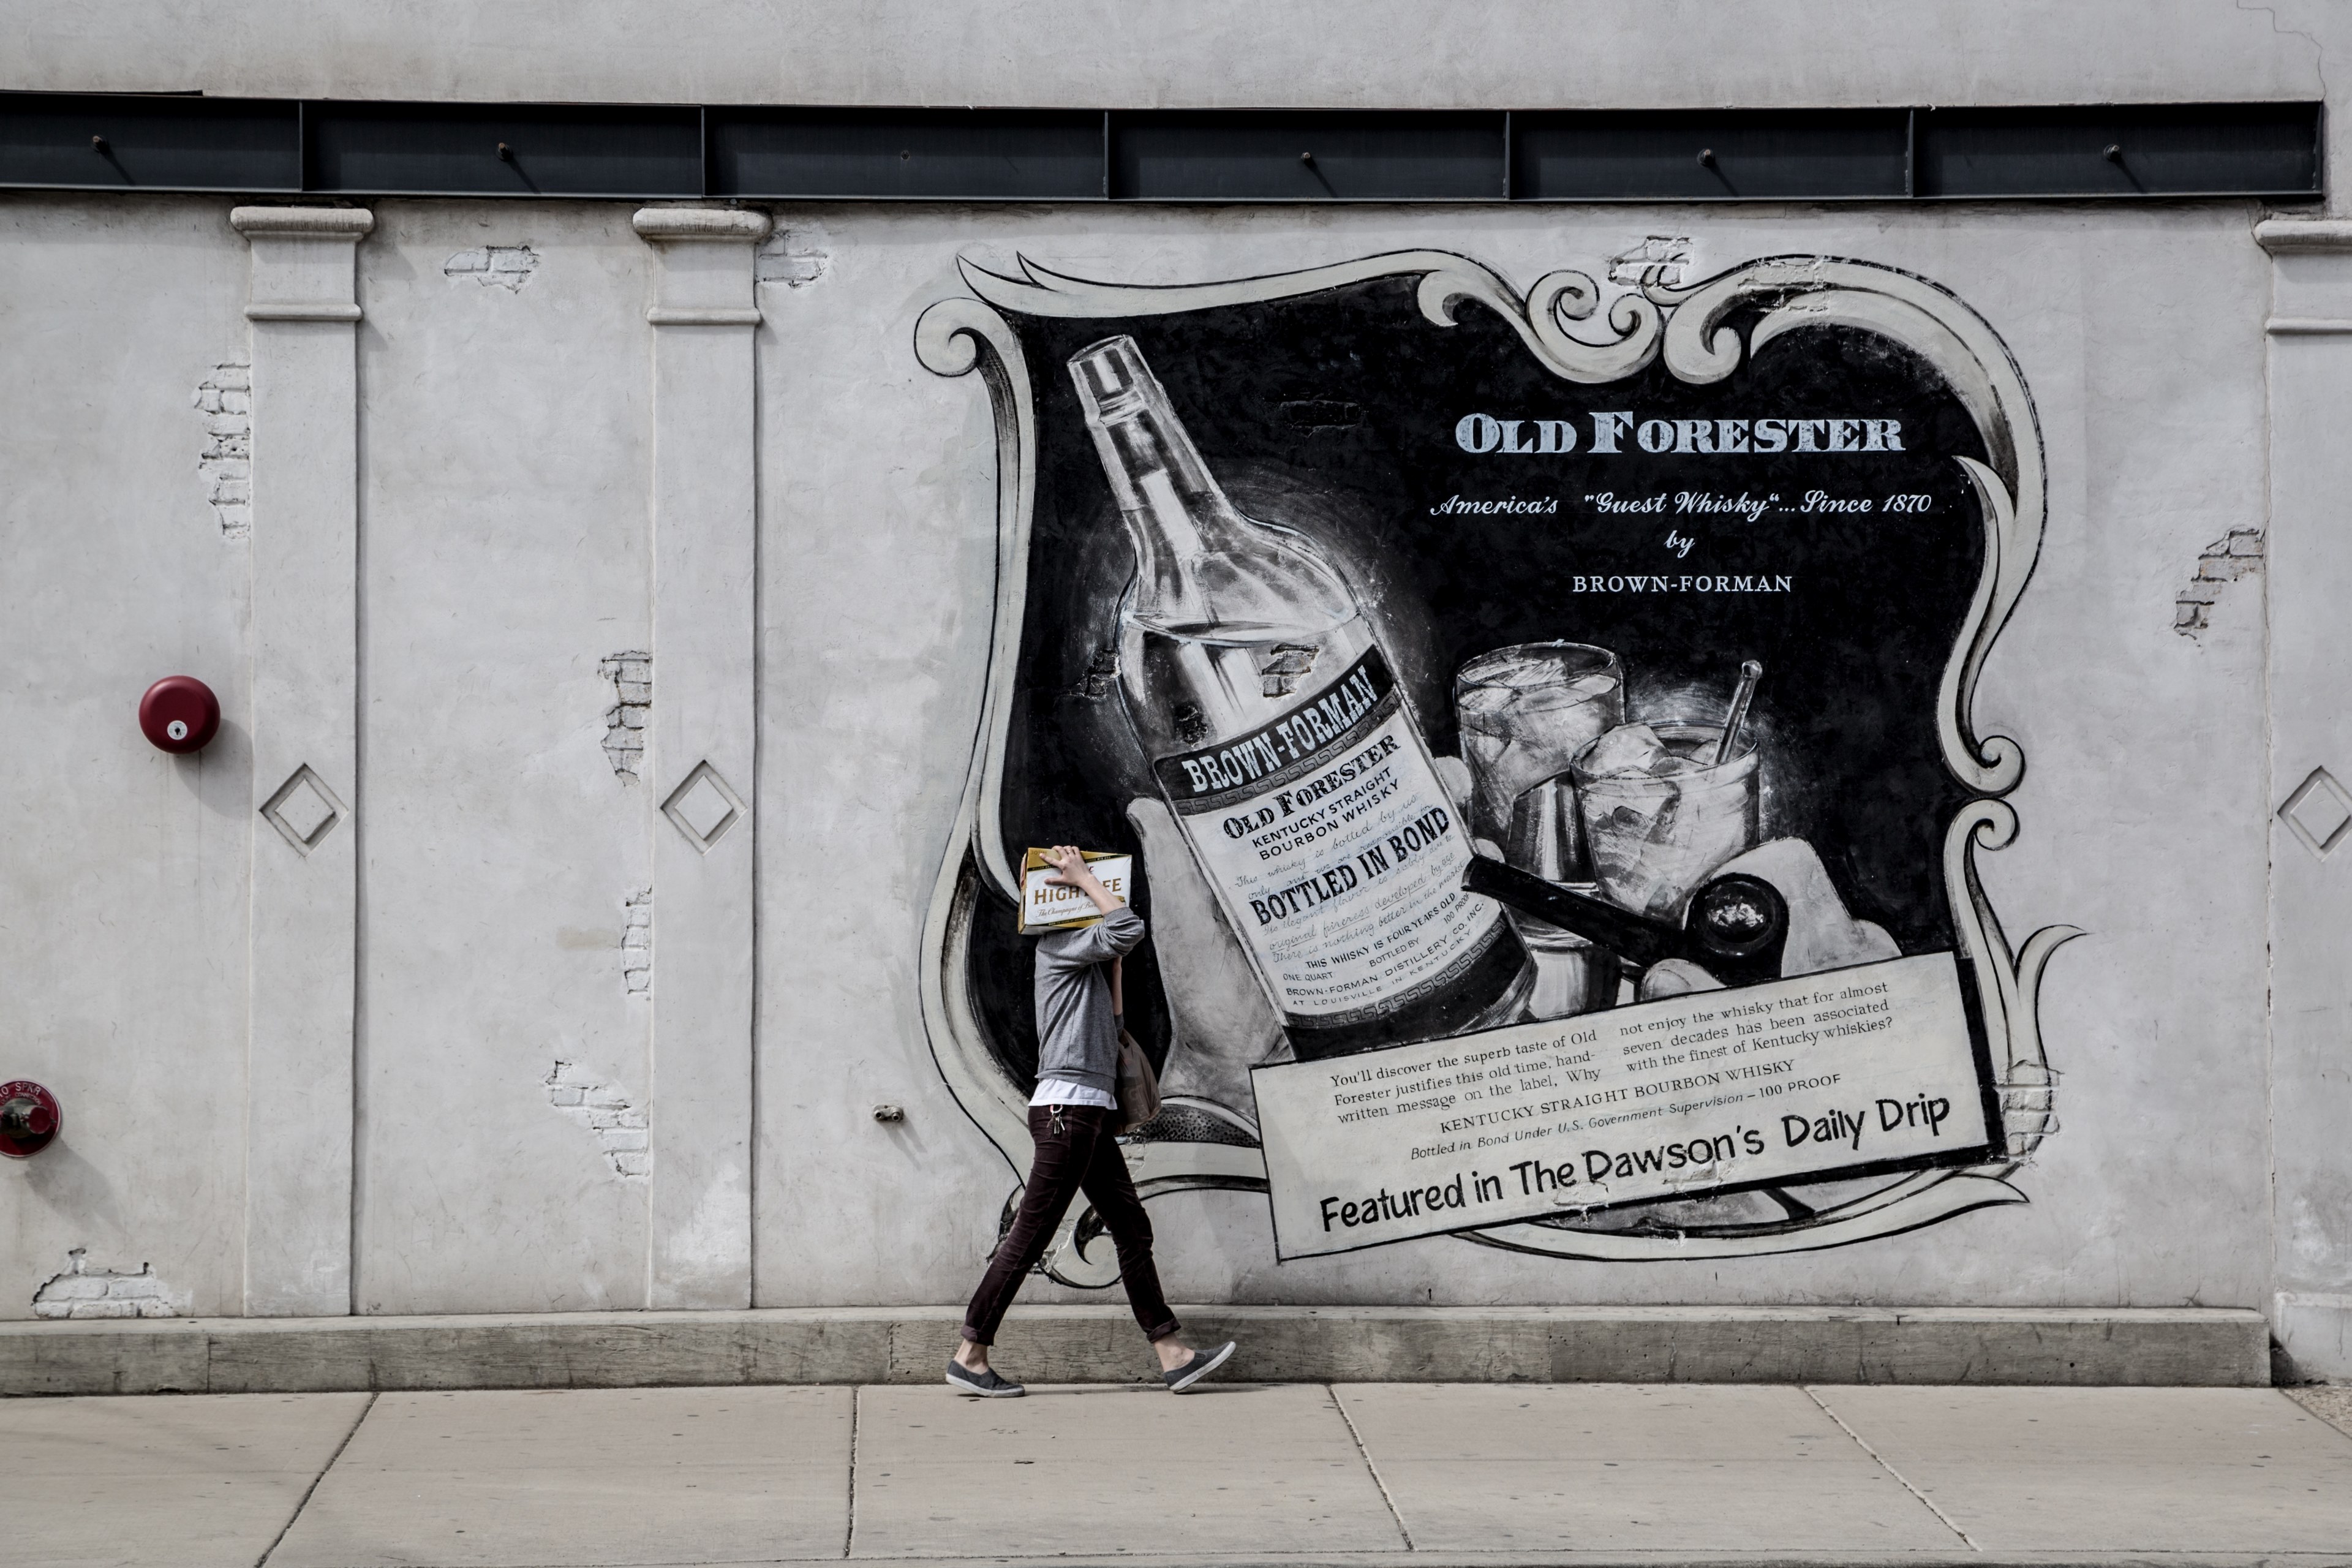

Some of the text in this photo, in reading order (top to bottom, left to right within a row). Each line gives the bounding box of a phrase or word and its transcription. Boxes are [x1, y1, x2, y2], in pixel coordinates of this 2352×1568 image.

[1455, 411, 1906, 453] OLD FORESTER
[1430, 494, 1558, 515] America's
[1800, 490, 1873, 513] Since
[1882, 494, 1932, 513] 1870
[1664, 530, 1695, 557] by
[1574, 575, 1792, 592] BROWN-FORMAN
[1182, 665, 1378, 793] BROWN-FORMAN
[1223, 734, 1401, 839] OLD FORESTER
[1252, 766, 1392, 848] KENTUCKY STRAIGHT
[1259, 782, 1400, 860] BOURBON WHISKY
[1268, 859, 1305, 877] whisky
[1316, 849, 1324, 858] is
[1378, 810, 1395, 823] by
[1248, 885, 1270, 900] only
[1249, 807, 1449, 926] BOTTLED IN BOND
[1034, 886, 1080, 905] HIGH
[1035, 908, 1047, 918] The
[1047, 906, 1077, 916] Champagne
[1270, 924, 1316, 952] original
[1375, 873, 1427, 909] developed
[1431, 865, 1442, 877] by
[1442, 853, 1454, 865] age
[1333, 887, 1370, 913] flavor
[1444, 892, 1469, 924] 100 PROOF
[1273, 952, 1301, 962] There
[1309, 945, 1317, 954] is
[1324, 924, 1374, 948] nothing
[1379, 907, 1406, 927] better
[1409, 899, 1422, 909] in
[1423, 888, 1437, 900] the
[1286, 903, 1484, 995] BROWN-FORMAN DISTILLERY CO. INC.
[1305, 892, 1455, 969] THIS WHISKY IS FOUR YEARS OLD
[1370, 937, 1420, 967] BOTTLED BY
[1305, 971, 1333, 982] QUART
[1314, 986, 1382, 1006] LOUISVILLE
[1392, 976, 1402, 985] IN
[1409, 929, 1471, 976] KENTUCKY
[1620, 982, 1888, 1036] not enjoy the whisky that for almost
[1623, 999, 1889, 1055] seven decades has been associated
[1330, 1029, 1597, 1087] You'll discover the superb taste of Old
[1626, 1016, 1892, 1072] with the finest of Kentucky whiskies?
[15, 1082, 41, 1095] SPKR
[1334, 1050, 1596, 1106] Forester justifies this old time, hand-
[1338, 1069, 1601, 1124] written message on the label, Why
[1440, 1059, 1795, 1133] KENTUCKY STRAIGHT BOURBON WHISKY
[1411, 1142, 1455, 1160] Bottled
[1460, 1140, 1471, 1151] in
[1477, 1133, 1509, 1147] Bond
[1515, 1126, 1552, 1142] Under
[1558, 1121, 1584, 1133] U.S.
[1588, 1106, 1663, 1128] Government
[1669, 1093, 1743, 1115] Supervision
[1760, 1084, 1782, 1098] 100
[1788, 1074, 1841, 1092] PROOF
[1319, 1093, 1950, 1232] Featured in The Dawson's Daily Drip
